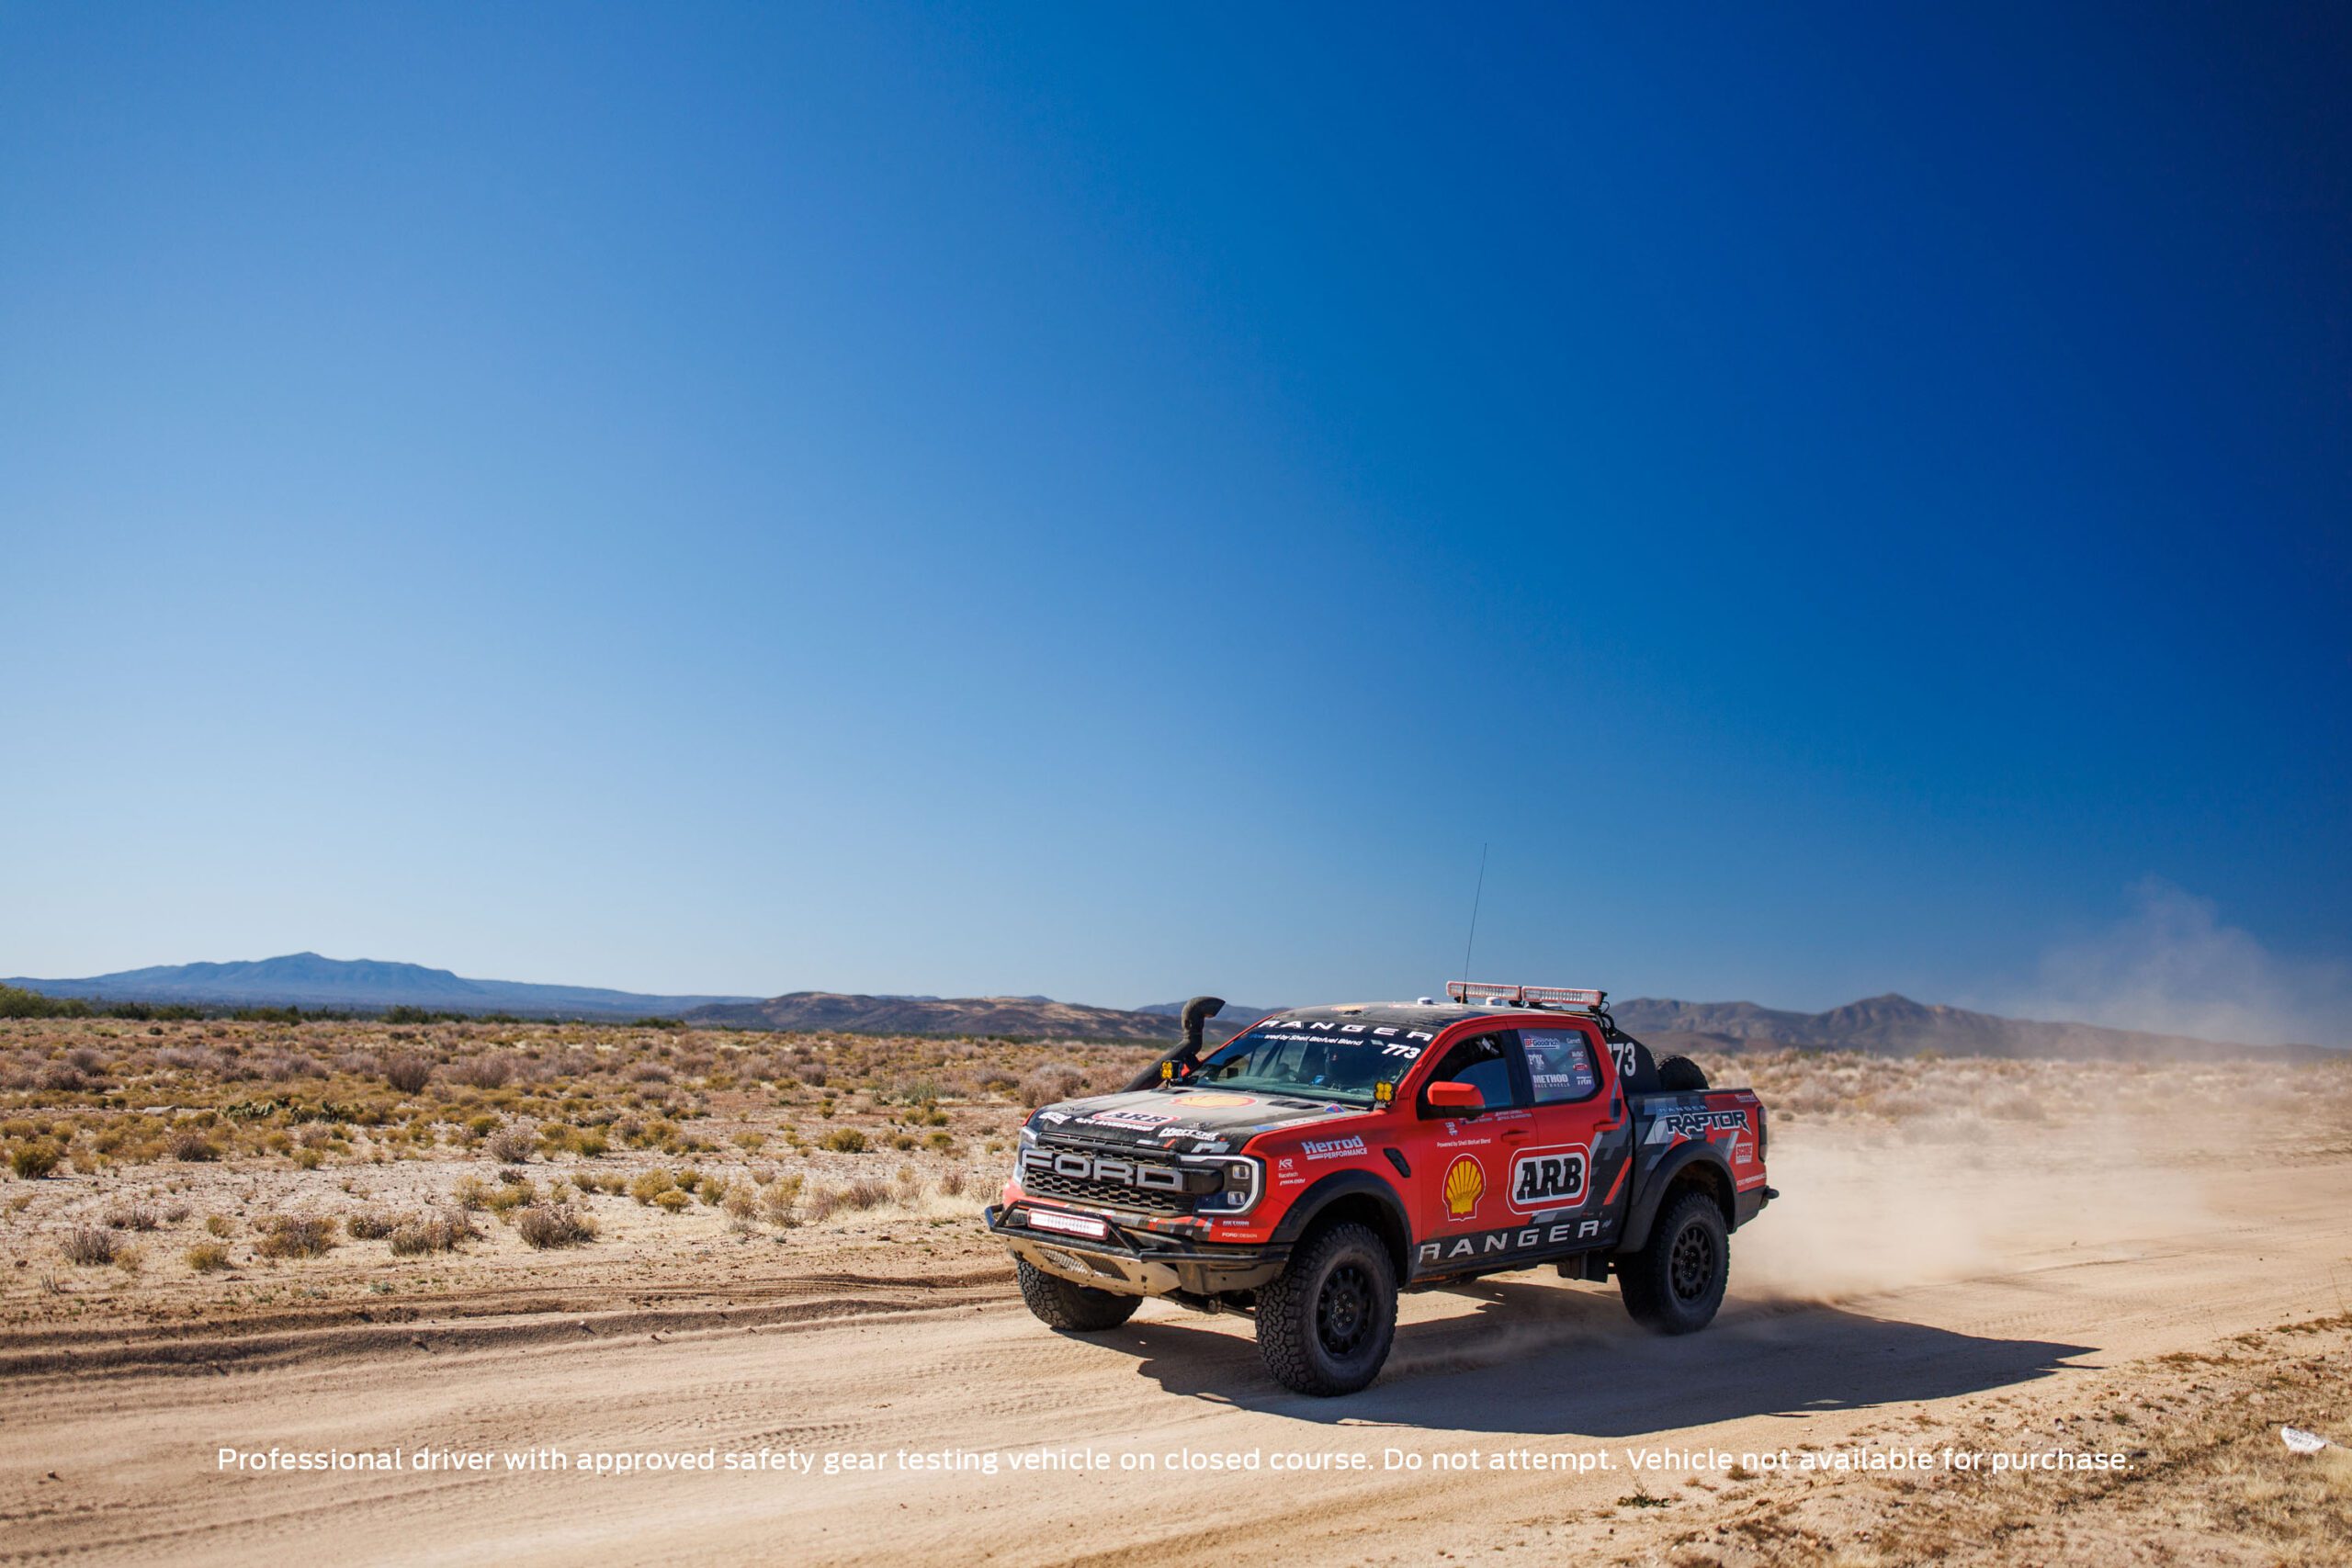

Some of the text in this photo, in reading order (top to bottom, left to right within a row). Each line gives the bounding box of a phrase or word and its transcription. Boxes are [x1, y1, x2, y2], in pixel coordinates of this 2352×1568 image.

[1259, 1021, 1433, 1041] RANGER
[1309, 1036, 1338, 1044] Biofuel
[1338, 1038, 1363, 1046] Blend
[1382, 1043, 1421, 1059] 773
[1524, 1038, 1559, 1046] BFGoodrich
[1532, 1074, 1569, 1084] METHOD
[1665, 1110, 1752, 1139] RAPTOR
[1301, 1135, 1364, 1155] Herrod
[1324, 1147, 1368, 1159] PERFORMANCE
[1022, 1149, 1183, 1192] FORD
[1516, 1157, 1582, 1200] ARB
[1419, 1220, 1600, 1264] RANGER
